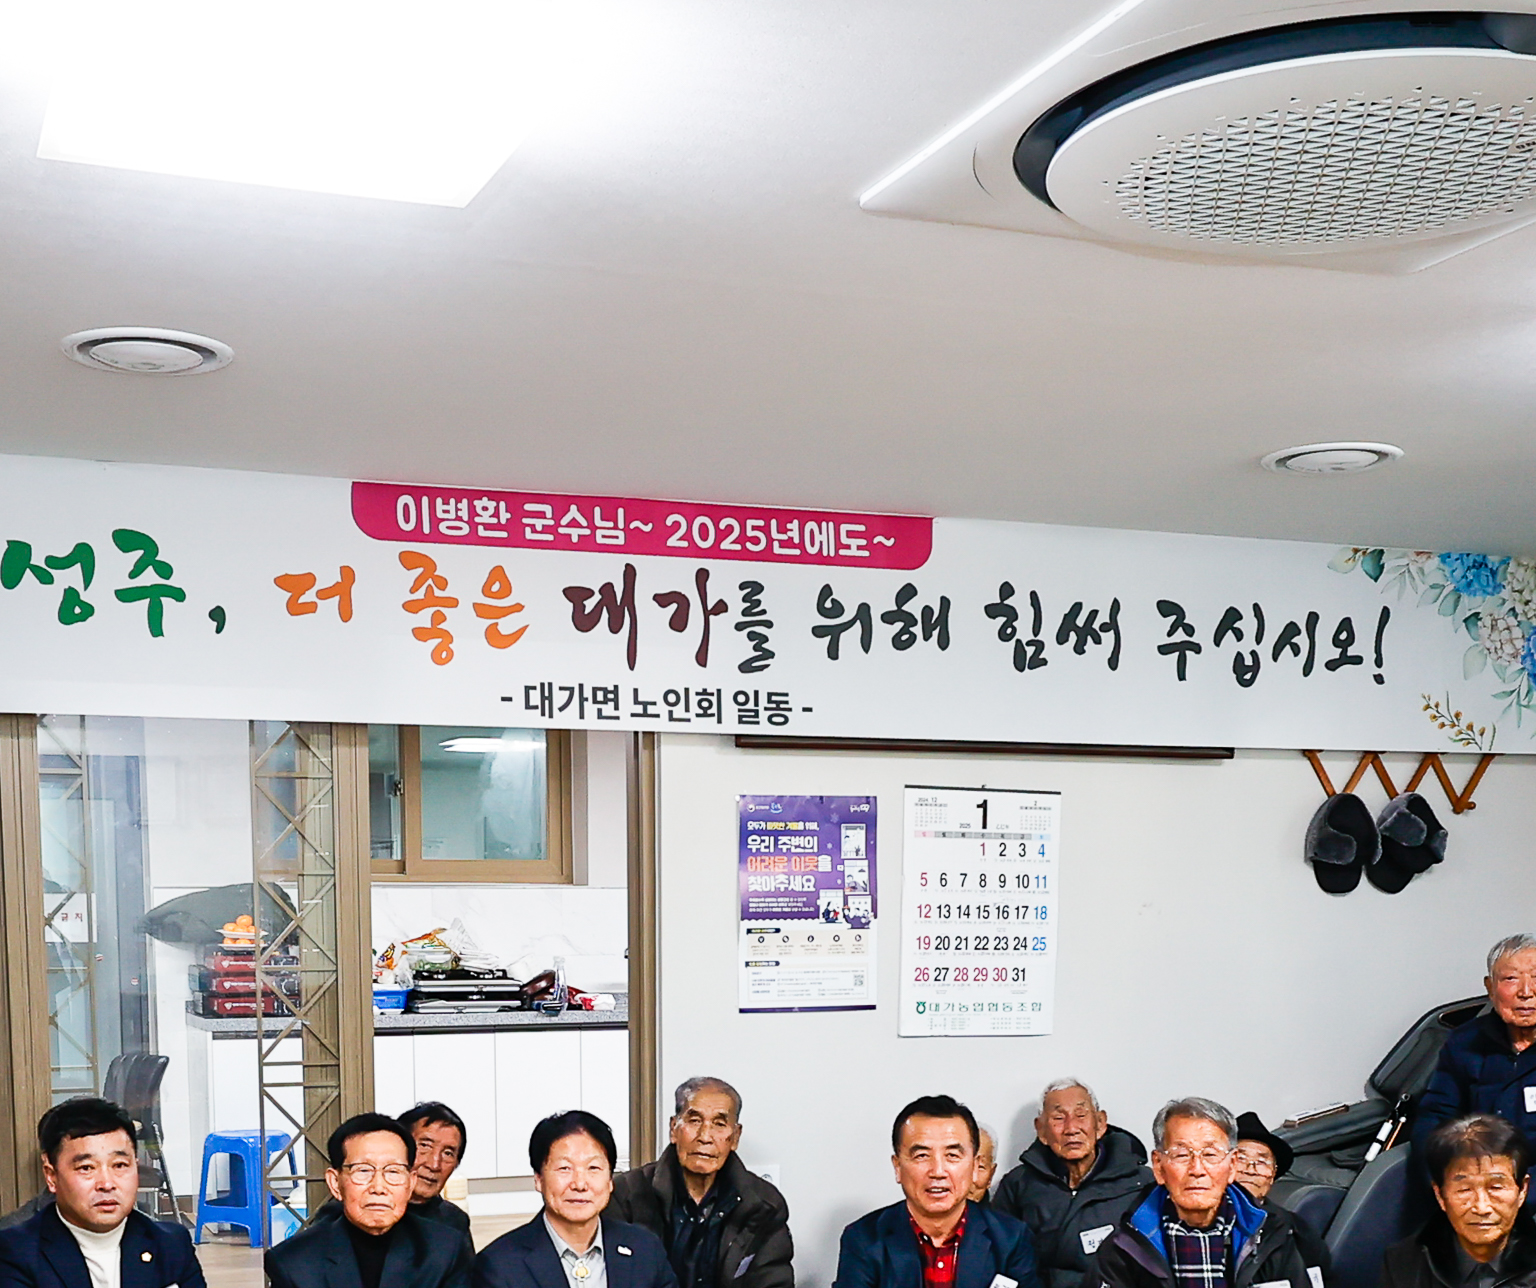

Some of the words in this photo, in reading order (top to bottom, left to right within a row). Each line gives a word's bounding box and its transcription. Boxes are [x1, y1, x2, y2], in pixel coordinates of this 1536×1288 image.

[396, 494, 510, 540] 이병환
[522, 500, 654, 548] 군수님~
[666, 511, 896, 558] 2025년에도~
[0, 528, 227, 635] 성주,
[274, 565, 357, 623] 더
[398, 550, 530, 666] 좋은
[562, 562, 777, 673] 대가를
[810, 581, 951, 661] 위해
[984, 581, 1122, 672] 힘써
[1156, 598, 1391, 687] 주십시오!
[523, 682, 621, 721] 대가면
[630, 686, 723, 725] 노인회
[732, 690, 793, 727] 일동
[976, 799, 988, 830] 1
[746, 835, 775, 853] 우리
[778, 835, 818, 853] 주변의
[980, 842, 986, 856] 1
[999, 842, 1007, 857] 2
[1018, 842, 1026, 857] 3
[1038, 844, 1046, 858] 4
[747, 855, 789, 873] 어려운
[791, 854, 832, 873] 이웃을
[747, 874, 816, 893] 찾아주세요
[920, 872, 928, 887] 5
[939, 872, 948, 887] 6
[959, 873, 968, 888] 7
[979, 873, 987, 888] 8
[998, 873, 1007, 888] 9
[1015, 874, 1030, 889] 10
[1034, 875, 1047, 889] 11
[917, 904, 932, 919] 12
[936, 904, 951, 919] 13
[956, 904, 971, 919] 14
[976, 905, 990, 920] 15
[995, 905, 1010, 920] 16
[1015, 905, 1029, 920] 17
[1034, 905, 1047, 920] 18
[916, 935, 931, 950] 19
[935, 936, 950, 951] 20
[954, 936, 969, 951] 21
[974, 936, 989, 951] 22
[993, 936, 1009, 951] 23
[1013, 936, 1028, 951] 24
[1032, 936, 1047, 951] 25
[914, 967, 930, 982] 26
[934, 967, 949, 982] 27
[953, 967, 969, 982] 28
[973, 967, 988, 982] 29
[992, 967, 1008, 982] 30
[1012, 967, 1026, 982] 31
[929, 1001, 1043, 1013] 대가농업협동조합
